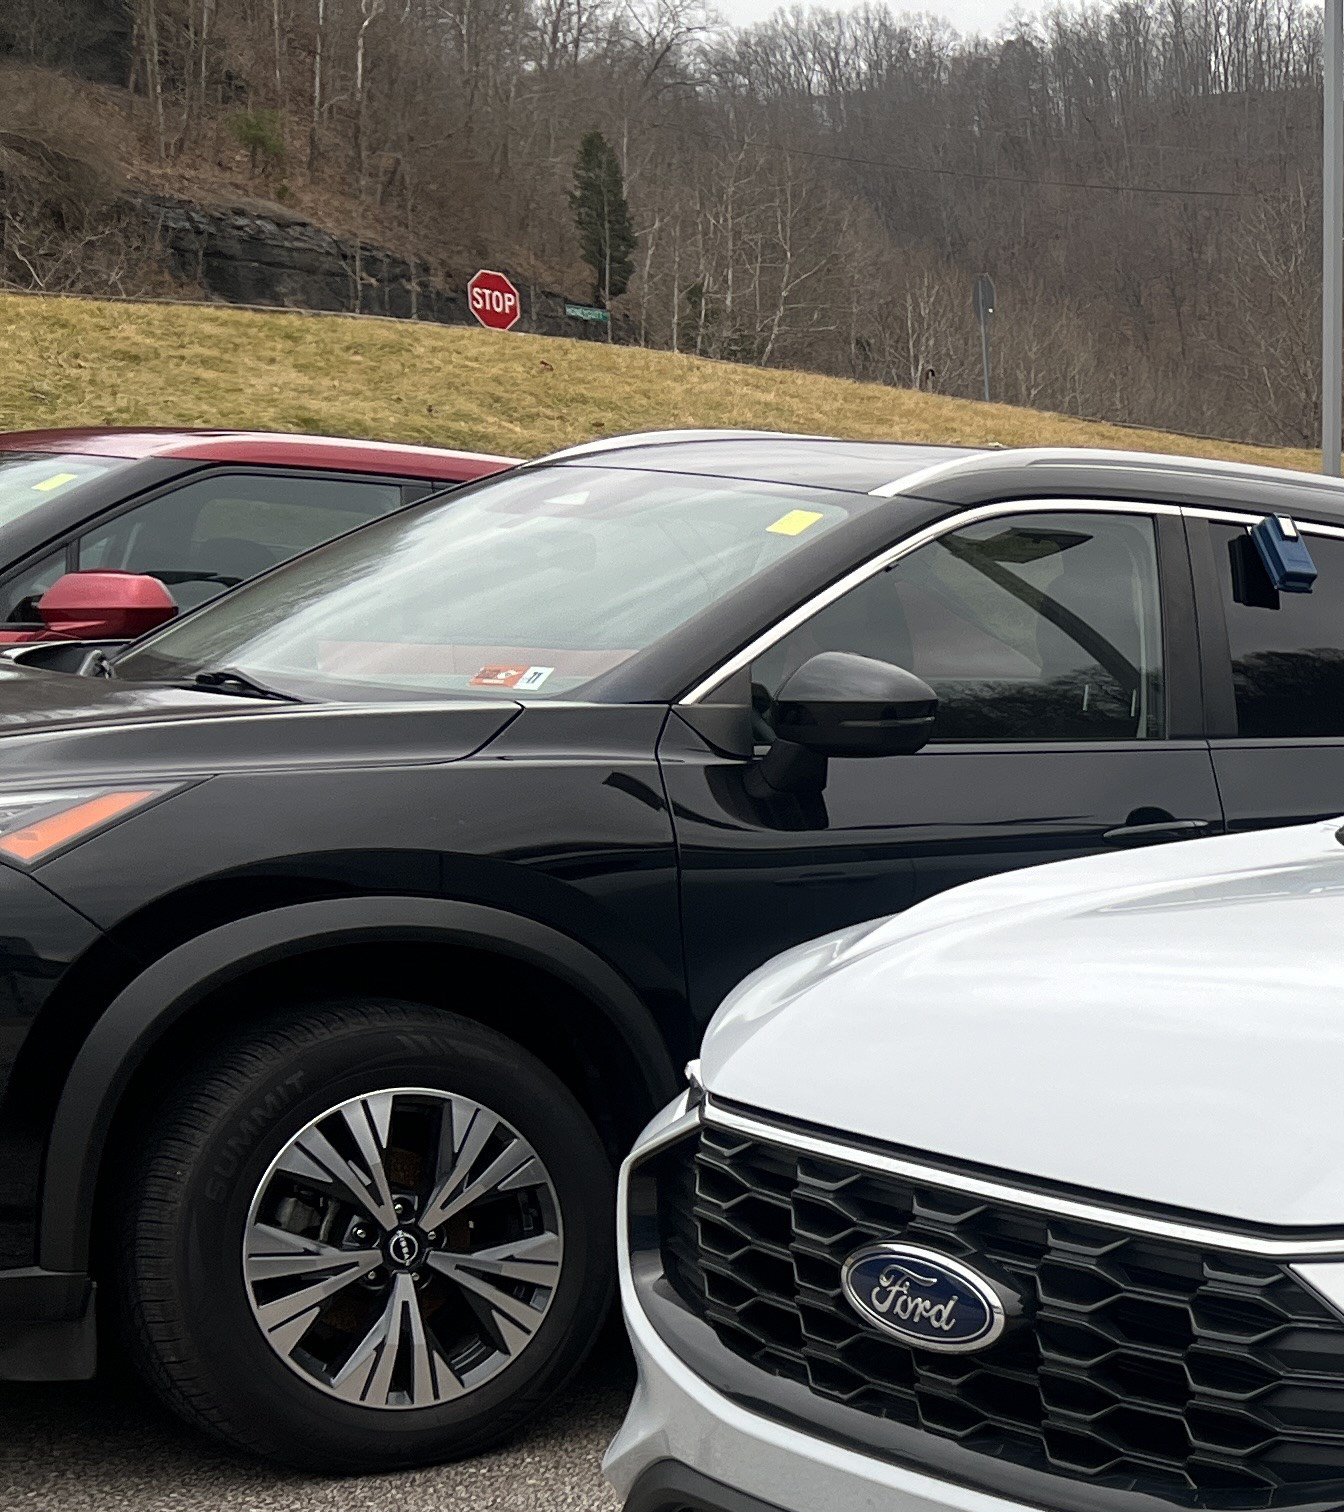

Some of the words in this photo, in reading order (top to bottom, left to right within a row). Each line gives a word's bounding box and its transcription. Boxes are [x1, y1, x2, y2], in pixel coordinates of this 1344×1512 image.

[472, 287, 515, 313] STOP
[526, 671, 543, 684] 11
[204, 1070, 304, 1202] SUMMIT
[871, 1265, 957, 1331] Ford
